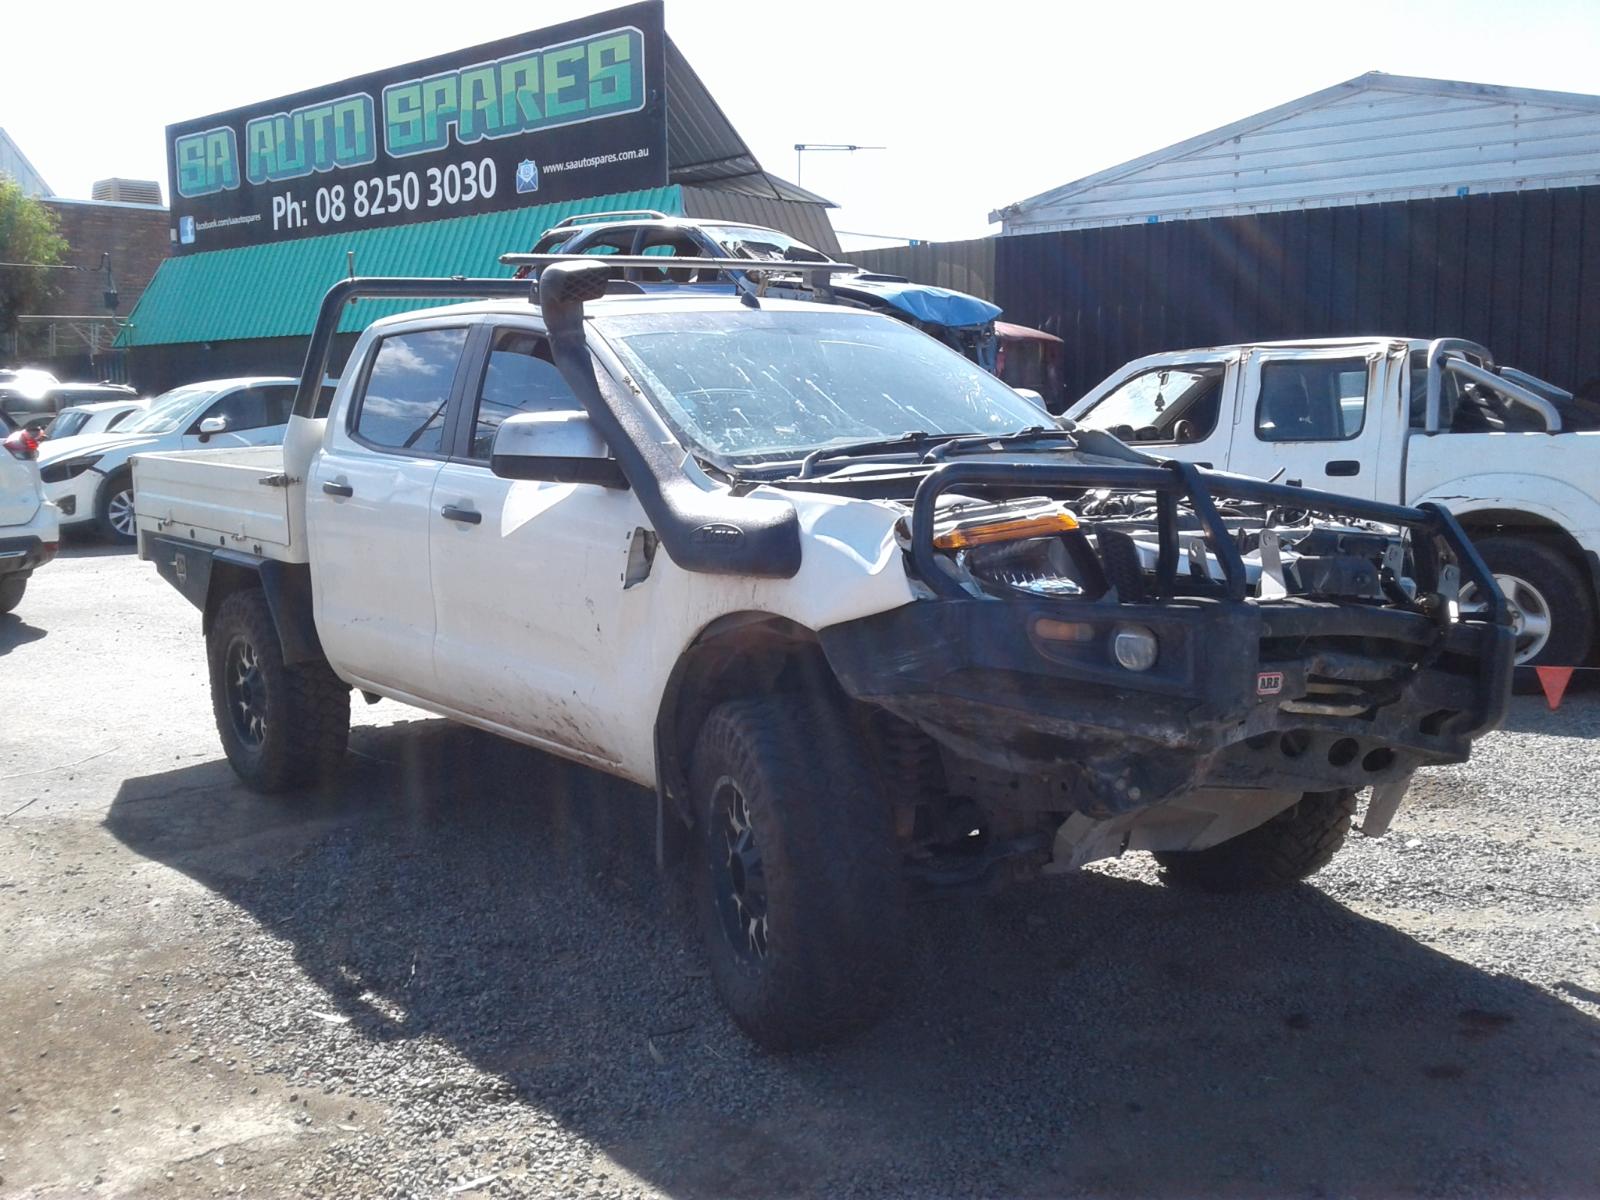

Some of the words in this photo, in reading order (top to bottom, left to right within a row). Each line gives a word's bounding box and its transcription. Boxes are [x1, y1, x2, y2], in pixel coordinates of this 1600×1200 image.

[178, 130, 235, 190] SA
[249, 98, 368, 177] AUTO
[386, 33, 633, 149] SPARES
[272, 191, 308, 231] Ph:
[315, 184, 346, 224] 08
[353, 171, 420, 218] 8250
[426, 157, 497, 207] 3030
[542, 147, 649, 175] www.saautospares.com.au
